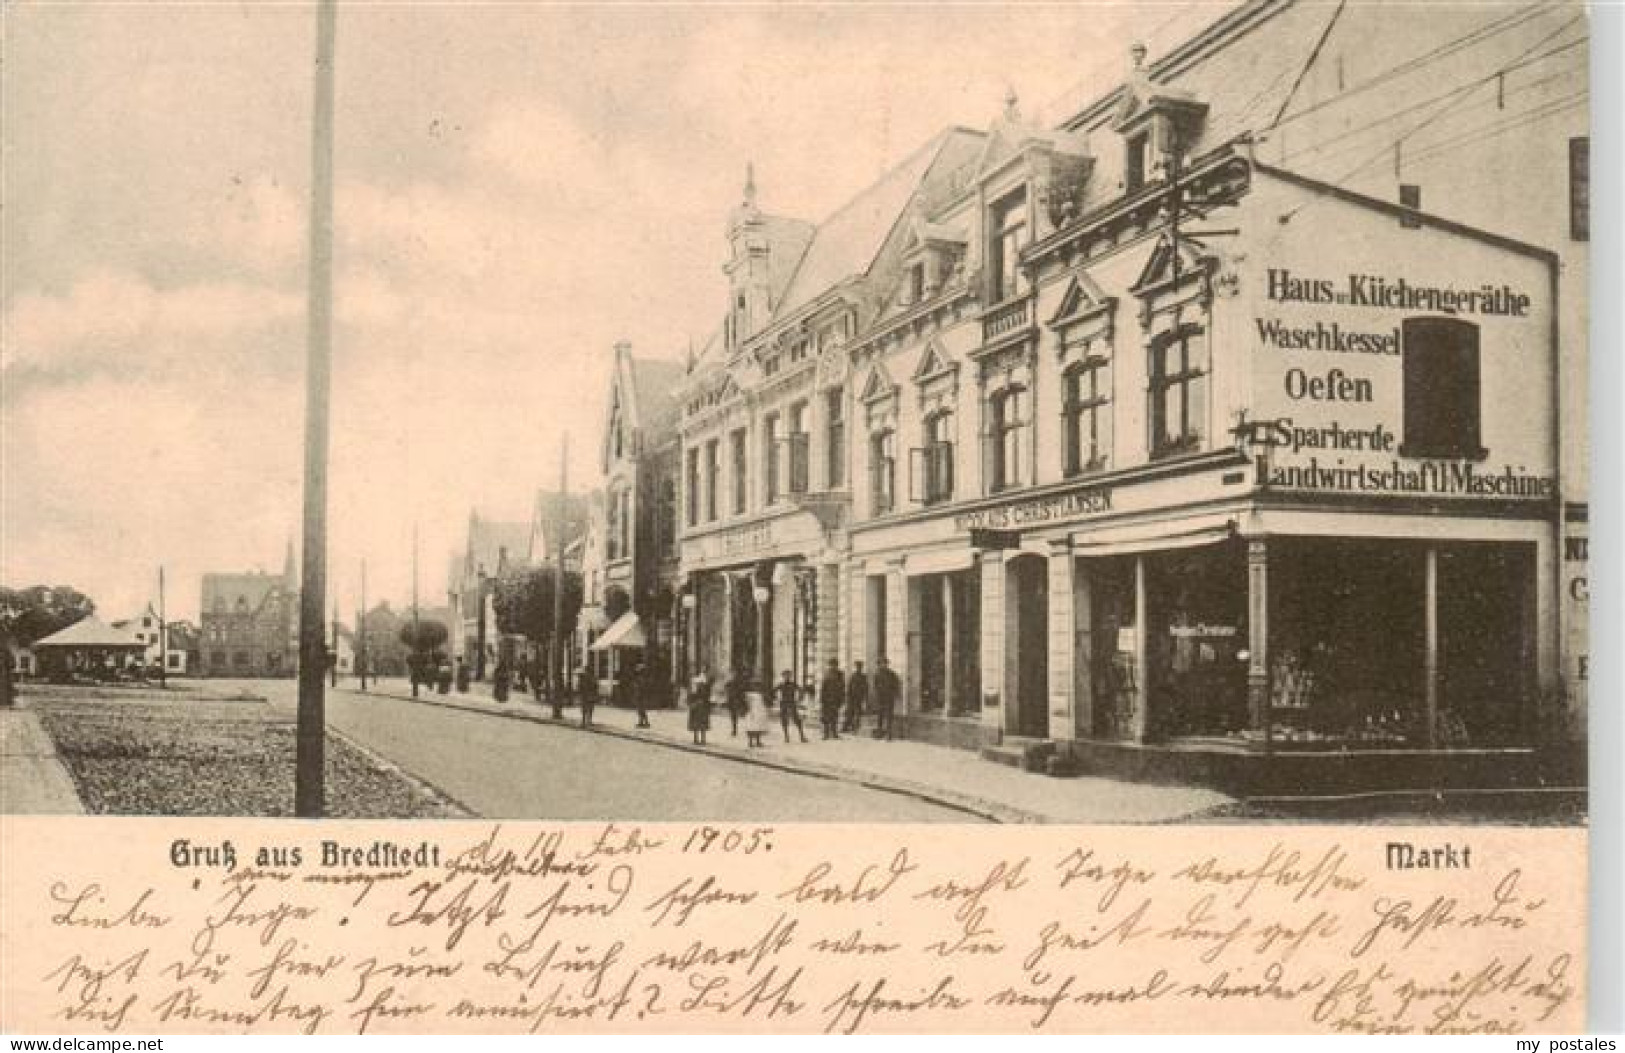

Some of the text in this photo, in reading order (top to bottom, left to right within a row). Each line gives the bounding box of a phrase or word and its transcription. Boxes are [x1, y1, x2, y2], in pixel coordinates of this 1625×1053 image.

[1266, 268, 1333, 303] Haus
[1349, 274, 1530, 316] Küchengeräthe
[1255, 317, 1400, 355] Waschkessel
[1284, 368, 1373, 402] Oefen
[1276, 418, 1394, 453] Sparherde
[170, 840, 440, 872] Gruß aus Bredstedt
[1387, 843, 1471, 869] Markt
